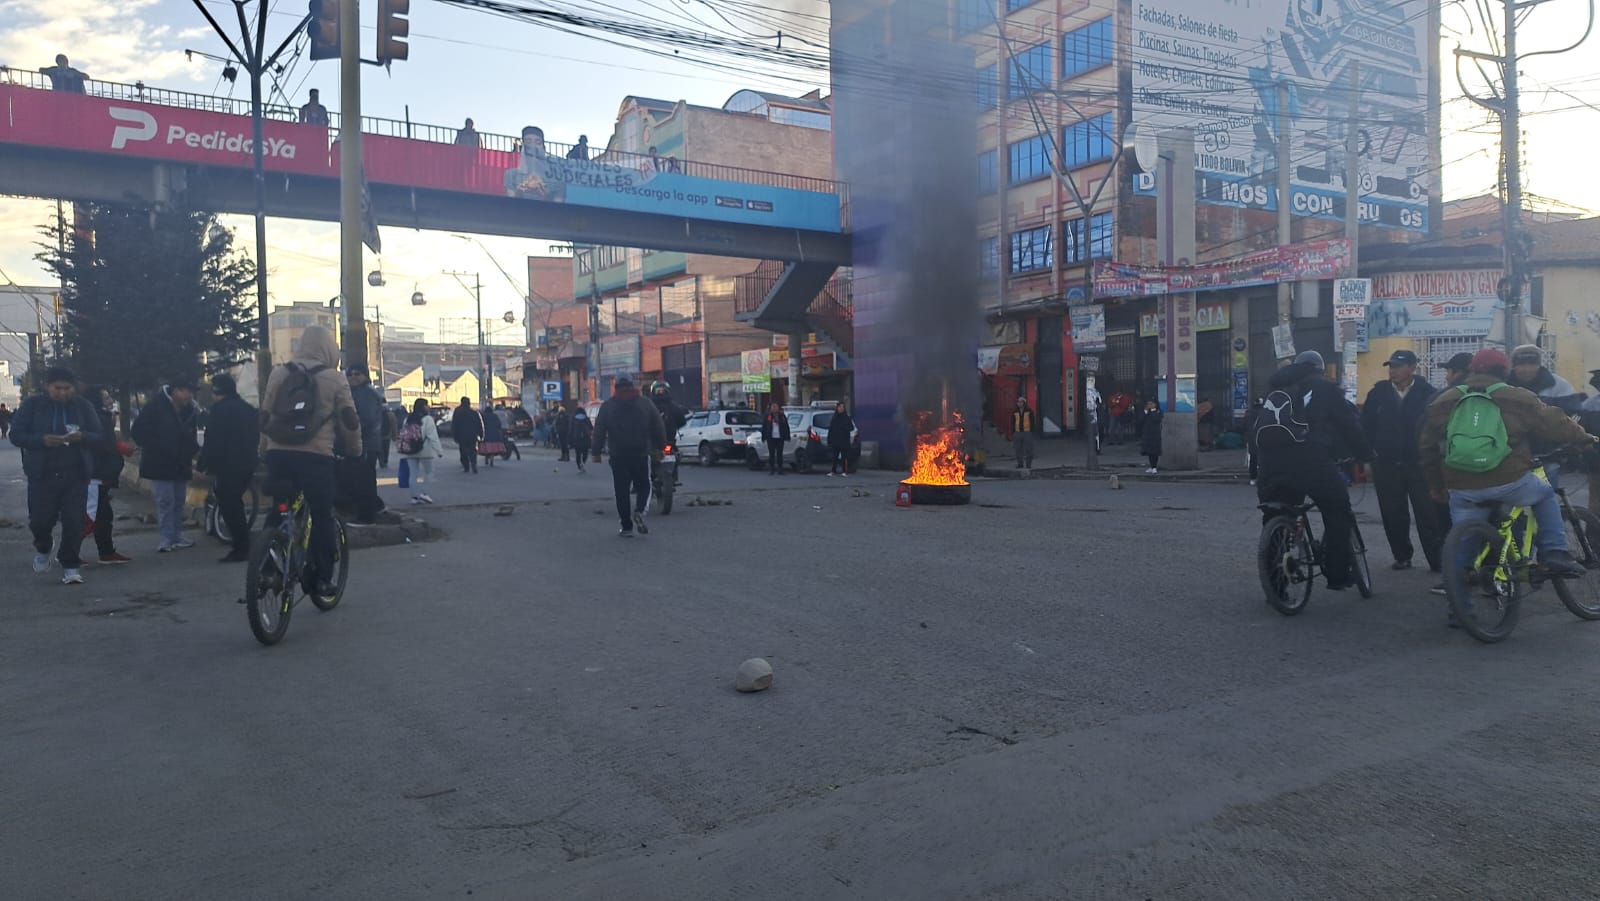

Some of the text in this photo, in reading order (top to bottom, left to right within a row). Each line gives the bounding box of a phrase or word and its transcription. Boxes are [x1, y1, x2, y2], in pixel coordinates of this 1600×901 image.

[1138, 4, 1177, 32] Fachadas,
[1179, 14, 1206, 36] Salones
[1208, 22, 1217, 39] de
[1204, 131, 1231, 153] 3D
[1201, 154, 1219, 171] TODO
[544, 167, 633, 188] JUDICIALES
[673, 188, 684, 201] la
[687, 193, 709, 206] app
[1372, 274, 1411, 299] MALLAS
[1413, 271, 1467, 297] OLIMPICAS
[1468, 271, 1476, 295] Y
[1142, 306, 1226, 333] FACIA
[1178, 316, 1191, 337] DE
[547, 383, 557, 393] P
